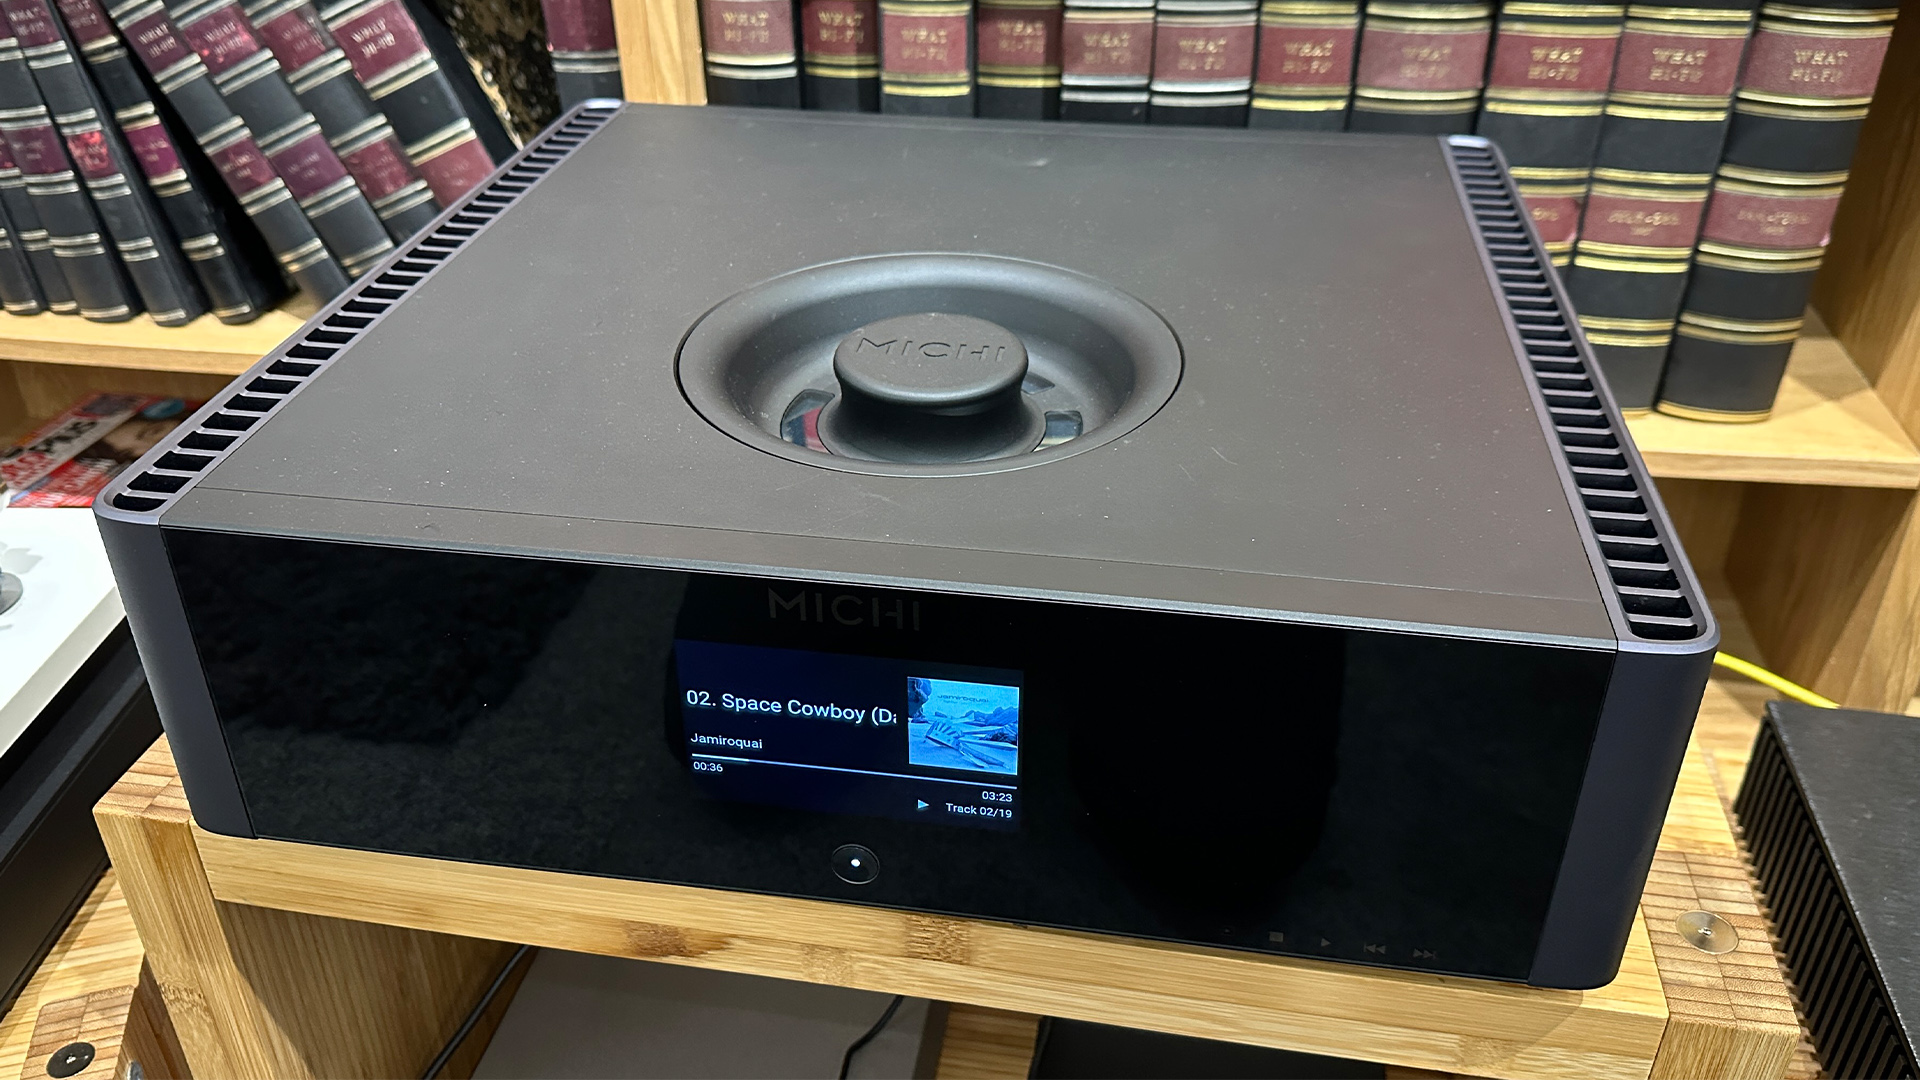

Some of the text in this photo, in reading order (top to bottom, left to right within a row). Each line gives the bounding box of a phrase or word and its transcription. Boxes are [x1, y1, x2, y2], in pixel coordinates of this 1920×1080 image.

[1652, 47, 1709, 65] WHAT
[1793, 49, 1850, 65] WHAT
[856, 337, 1005, 362] MICHI
[767, 586, 920, 631] MICHI
[686, 690, 716, 707] 02.
[722, 693, 782, 712] Space
[787, 699, 865, 724] Cowboy
[690, 733, 763, 749] Jamiroquai
[693, 761, 724, 772] 00:36
[981, 791, 1013, 802] 03:23
[945, 802, 1012, 818] Track 02/19
